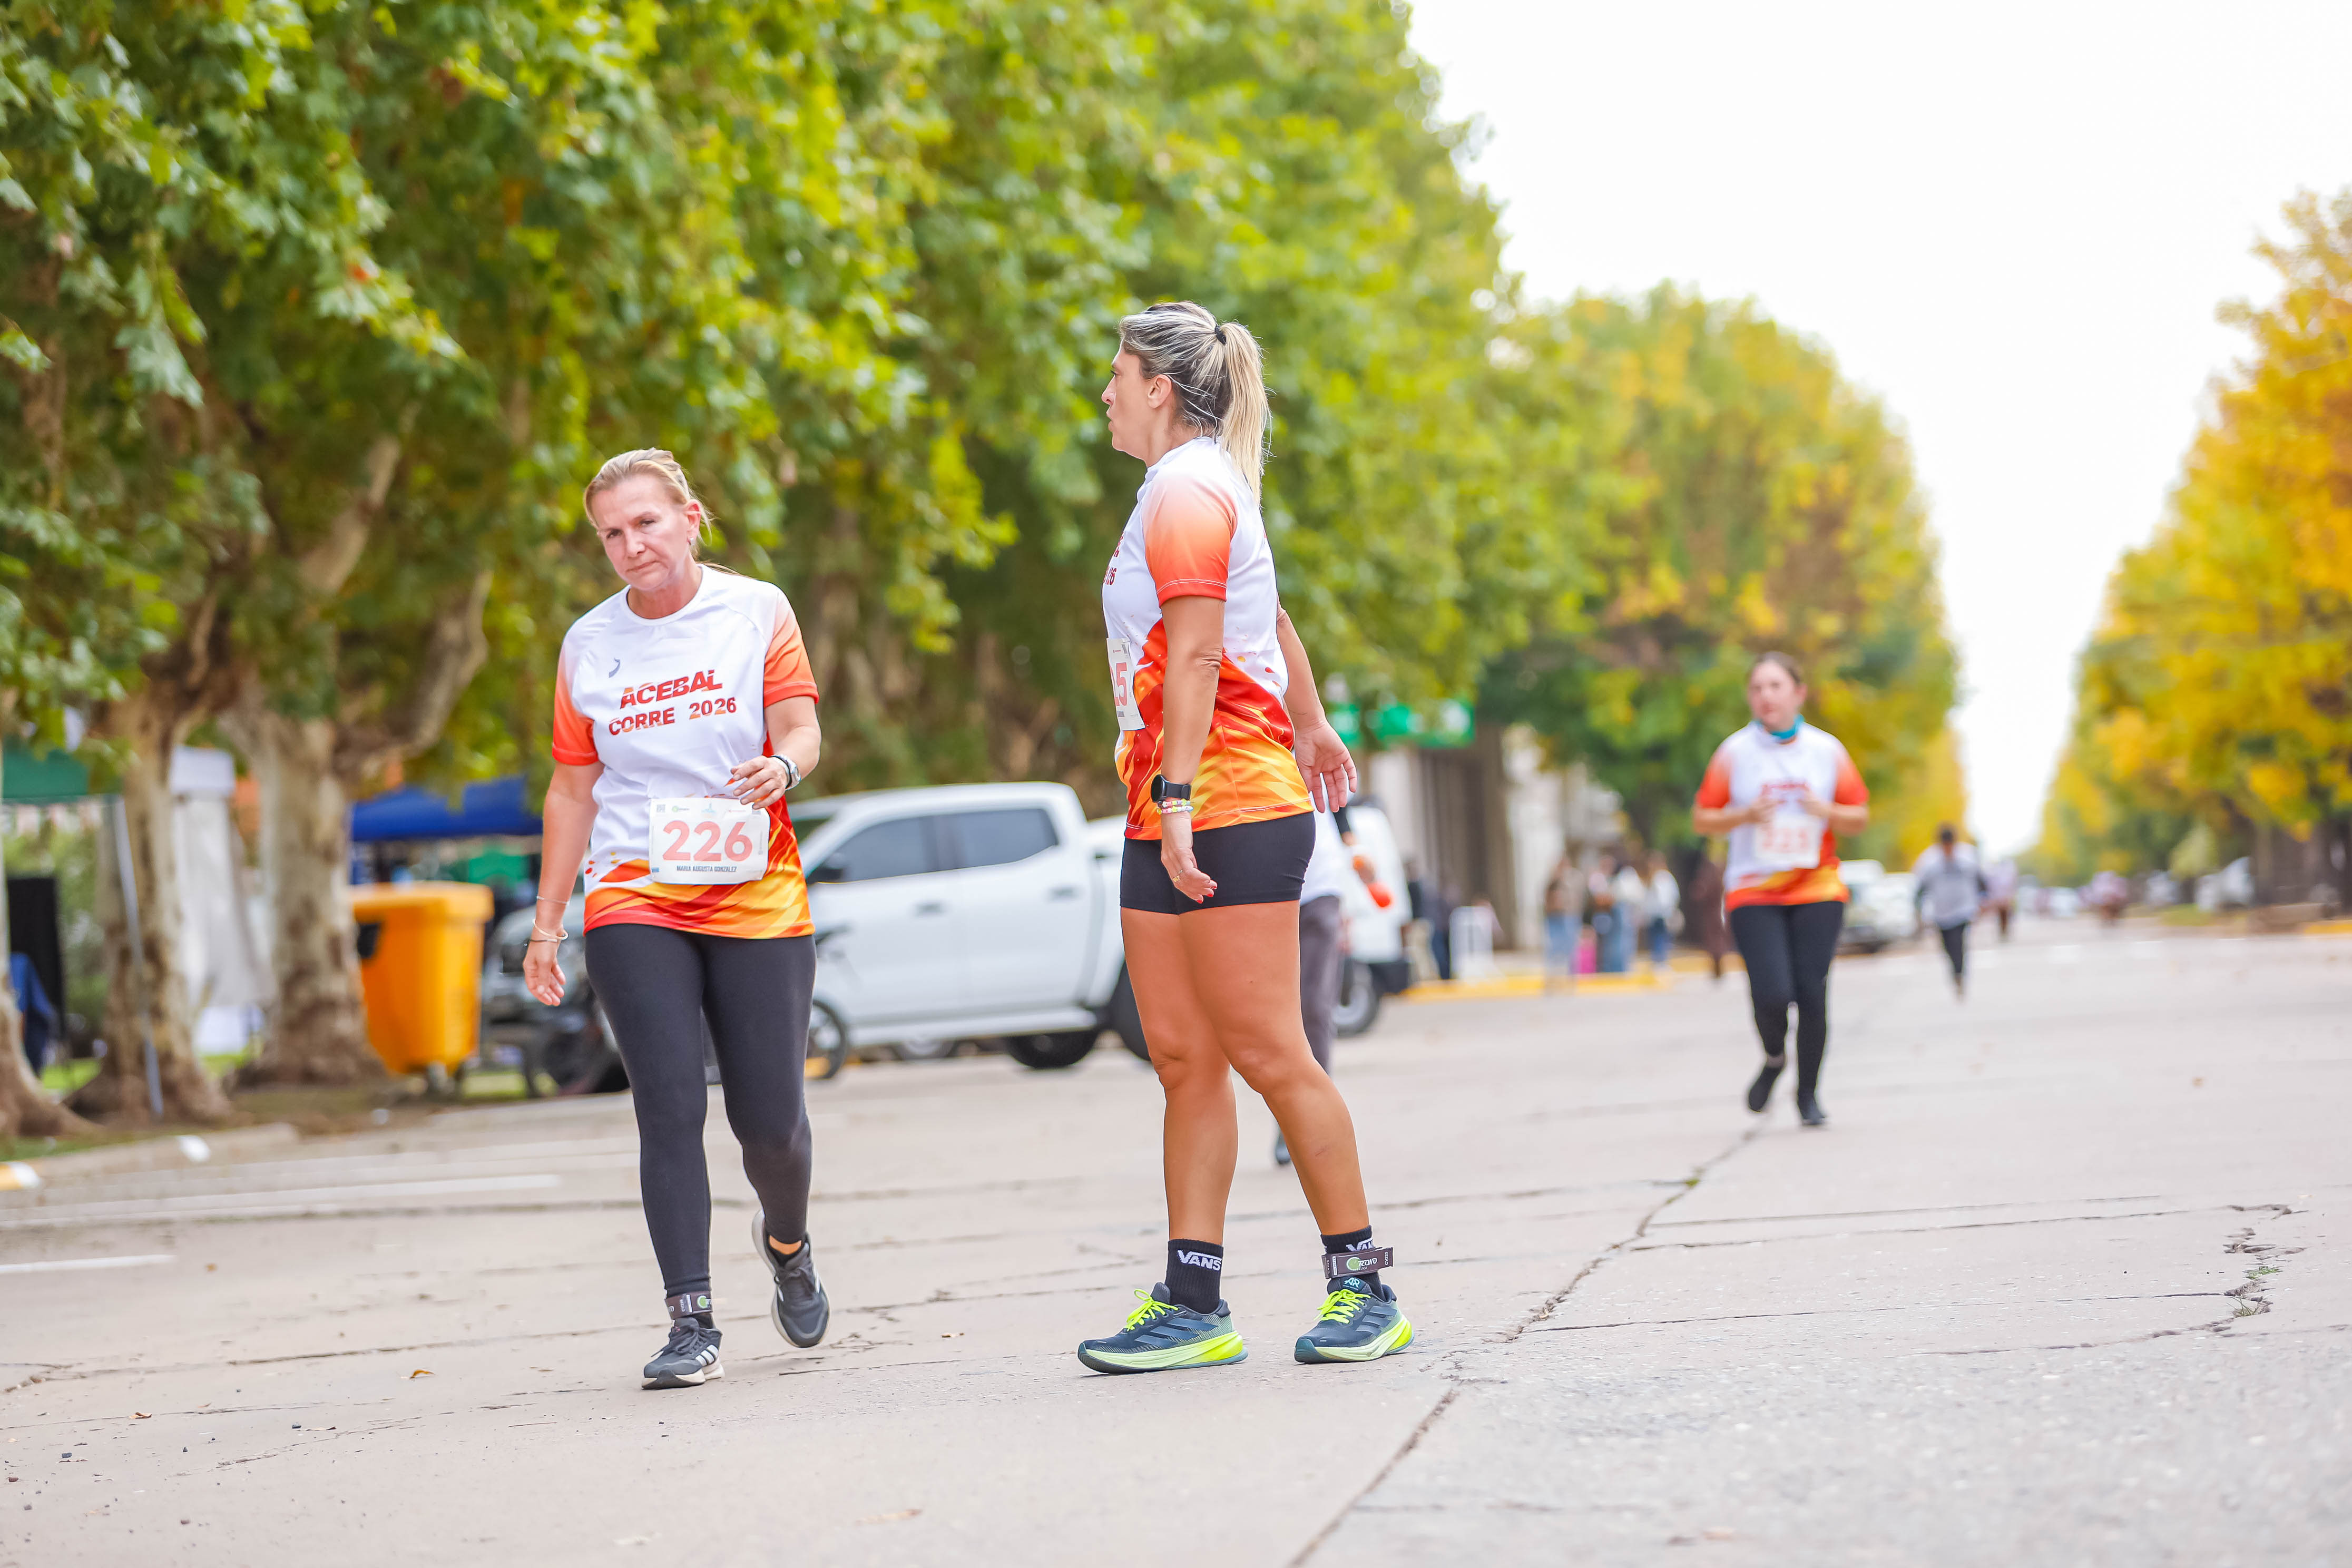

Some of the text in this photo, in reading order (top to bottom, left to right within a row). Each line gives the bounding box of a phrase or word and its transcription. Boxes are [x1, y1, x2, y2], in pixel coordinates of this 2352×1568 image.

[620, 669, 723, 709] ACEBAL
[609, 697, 737, 736] CORRE 2026
[662, 820, 753, 862] 226
[1177, 1250, 1222, 1271] VANS
[1346, 1238, 1374, 1252] VAN
